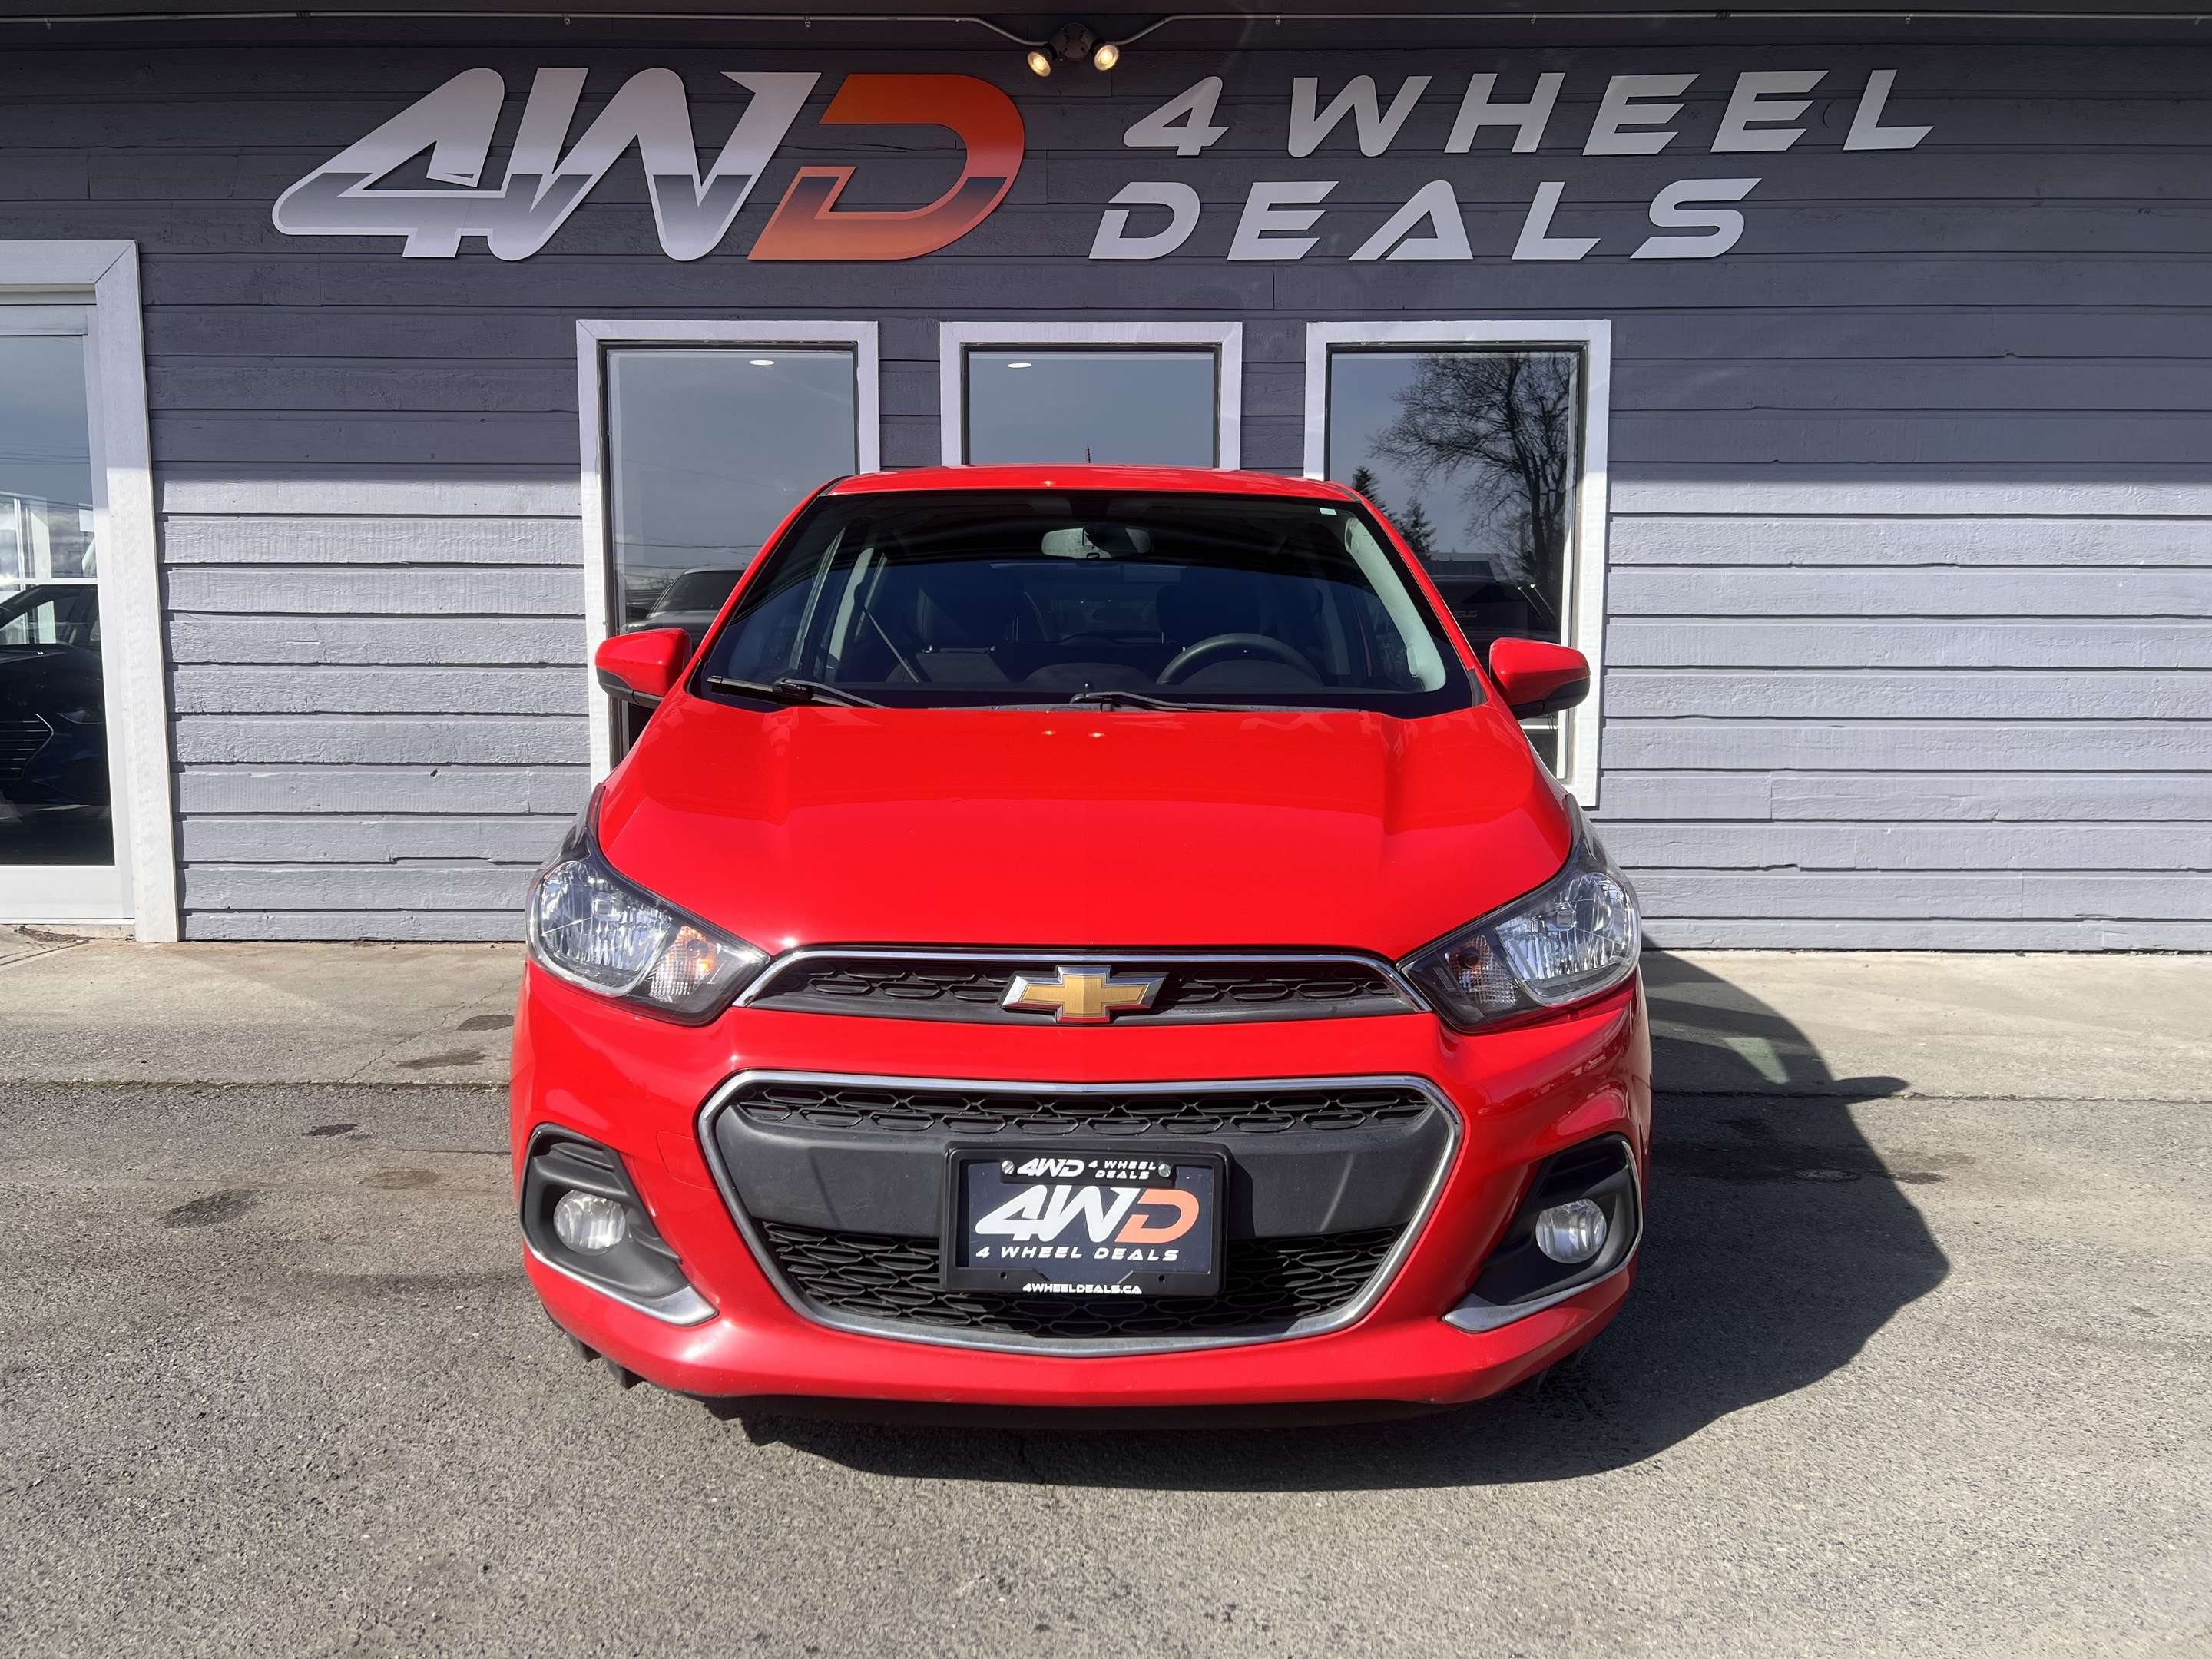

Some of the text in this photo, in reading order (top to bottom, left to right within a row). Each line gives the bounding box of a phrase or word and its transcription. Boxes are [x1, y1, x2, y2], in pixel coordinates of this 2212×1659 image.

[1122, 68, 1935, 158] 4 WHEEL
[272, 67, 1025, 262] 4WD
[1088, 177, 1763, 261] DEALS
[1017, 1158, 1084, 1177] 4WD
[1088, 1160, 1157, 1171] 4 WHEEL
[1094, 1169, 1150, 1180] DEALS
[975, 1184, 1200, 1244] 4WD
[975, 1246, 1180, 1262] 4 WHEEL DEALS
[1022, 1283, 1143, 1295] 4WHEELDEALS.CA
